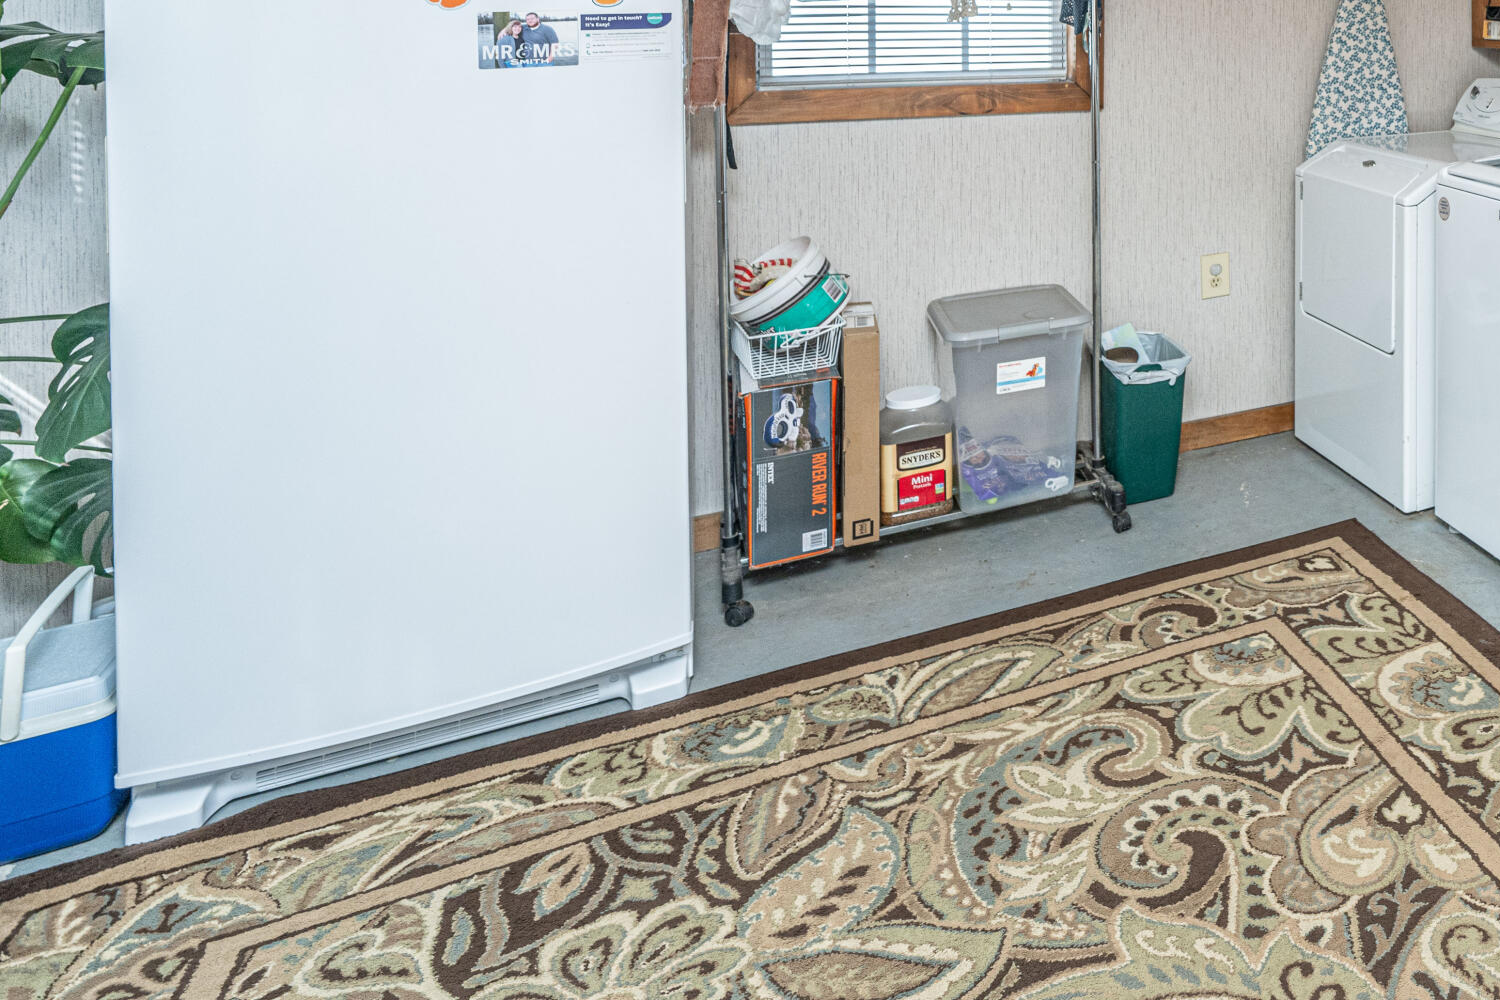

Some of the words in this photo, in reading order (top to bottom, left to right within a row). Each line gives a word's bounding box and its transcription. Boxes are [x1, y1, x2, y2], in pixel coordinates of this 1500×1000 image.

[482, 45, 513, 61] MR
[515, 42, 533, 60] &
[533, 42, 576, 59] MRS
[510, 58, 550, 66] SMITH
[901, 450, 941, 465] SNYDER'S
[812, 452, 827, 483] RIVER
[911, 473, 933, 486] Mini
[812, 483, 827, 505] RUN
[812, 507, 827, 517] 2
